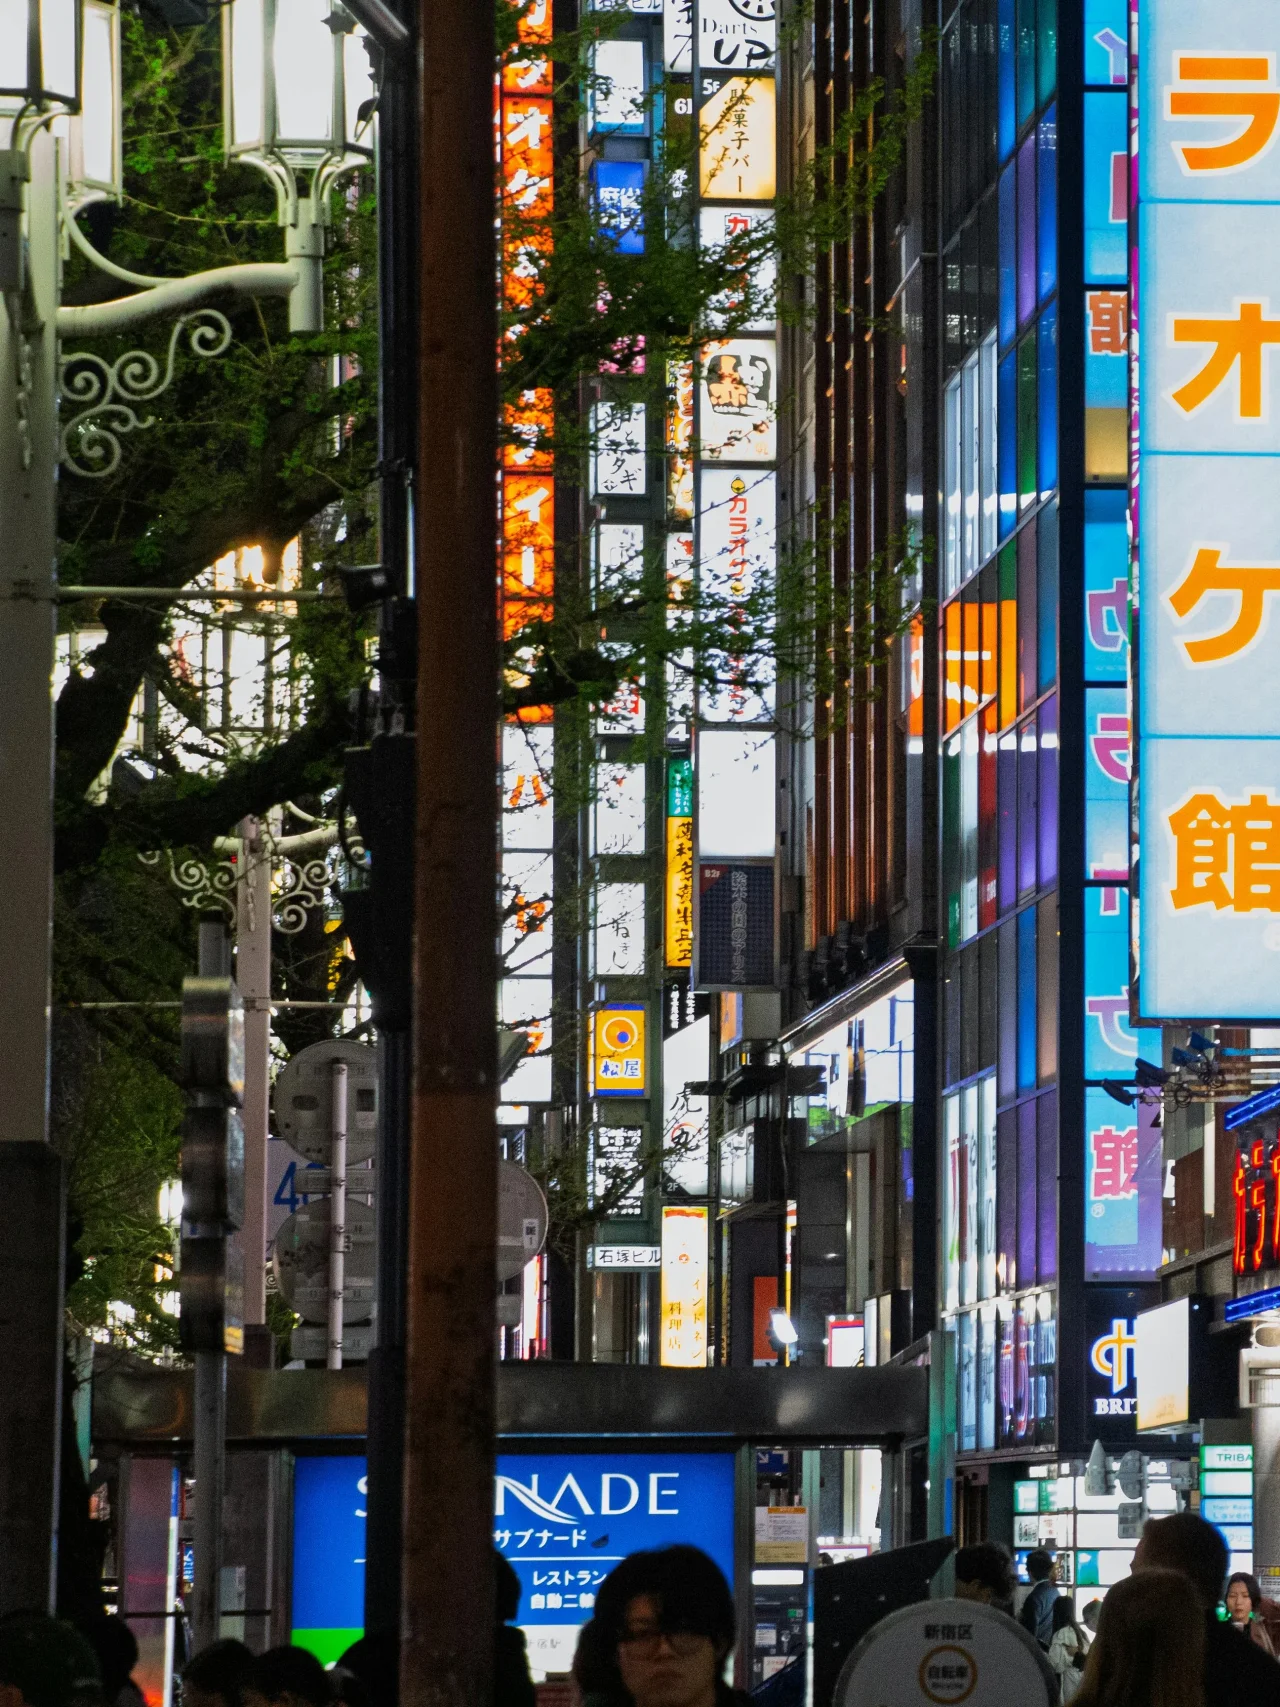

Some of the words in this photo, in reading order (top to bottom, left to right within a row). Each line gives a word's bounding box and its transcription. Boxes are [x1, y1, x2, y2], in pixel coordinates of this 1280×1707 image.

[703, 18, 757, 34] Darts
[714, 39, 775, 68] UP
[703, 79, 720, 95] 5F
[704, 868, 721, 879] B2F
[600, 1059, 641, 1078] 松屋
[667, 1182, 679, 1192] 2F
[599, 1249, 661, 1263] 石塚ビル
[669, 1301, 682, 1349] 料理店
[494, 1528, 587, 1549] サブナード
[533, 1569, 607, 1587] レストラン
